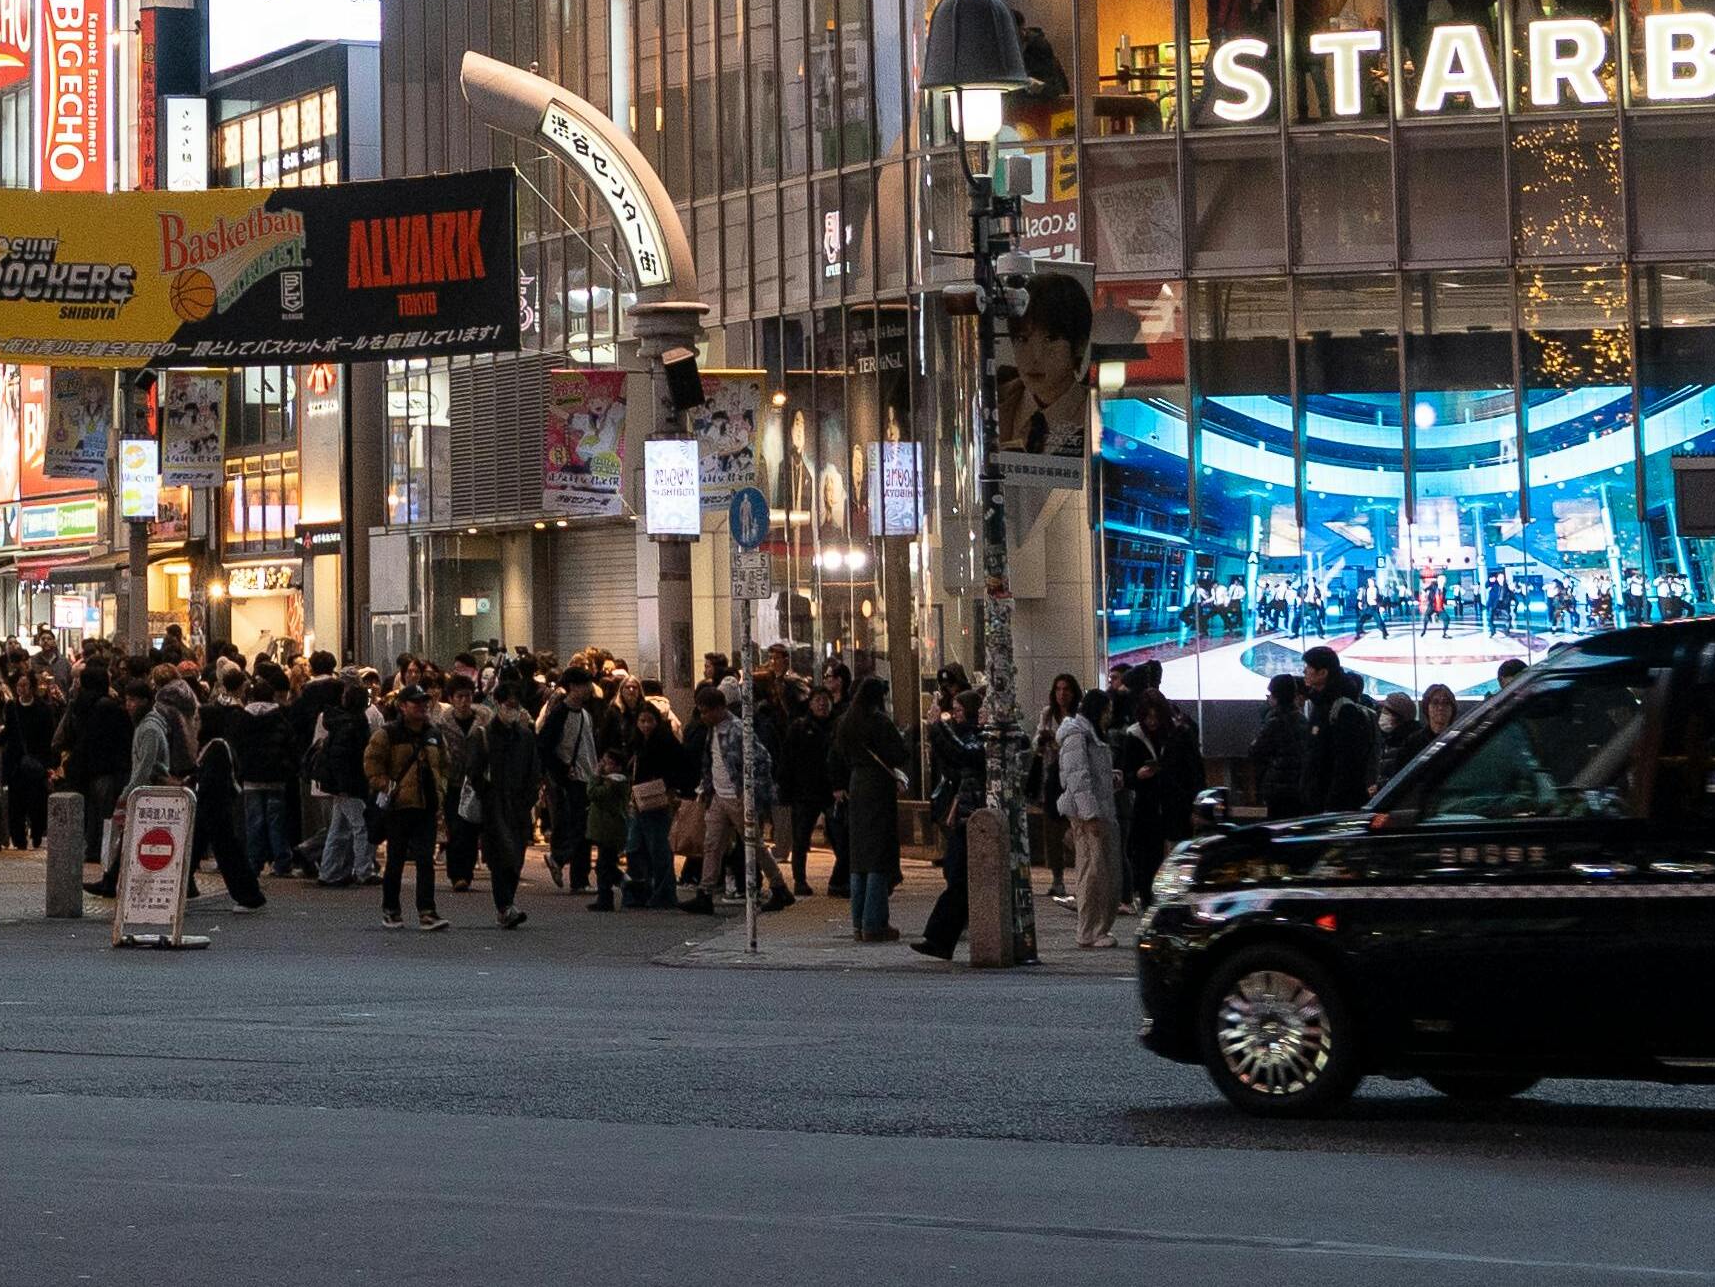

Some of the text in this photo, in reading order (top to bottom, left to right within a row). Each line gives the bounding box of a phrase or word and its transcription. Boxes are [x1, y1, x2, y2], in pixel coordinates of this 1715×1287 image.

[47, 74, 85, 182] ECHO
[551, 112, 660, 278] 渋谷センター街
[10, 236, 59, 261] SUN
[347, 208, 488, 290] ALVARK
[58, 305, 117, 321] SHIBUYA
